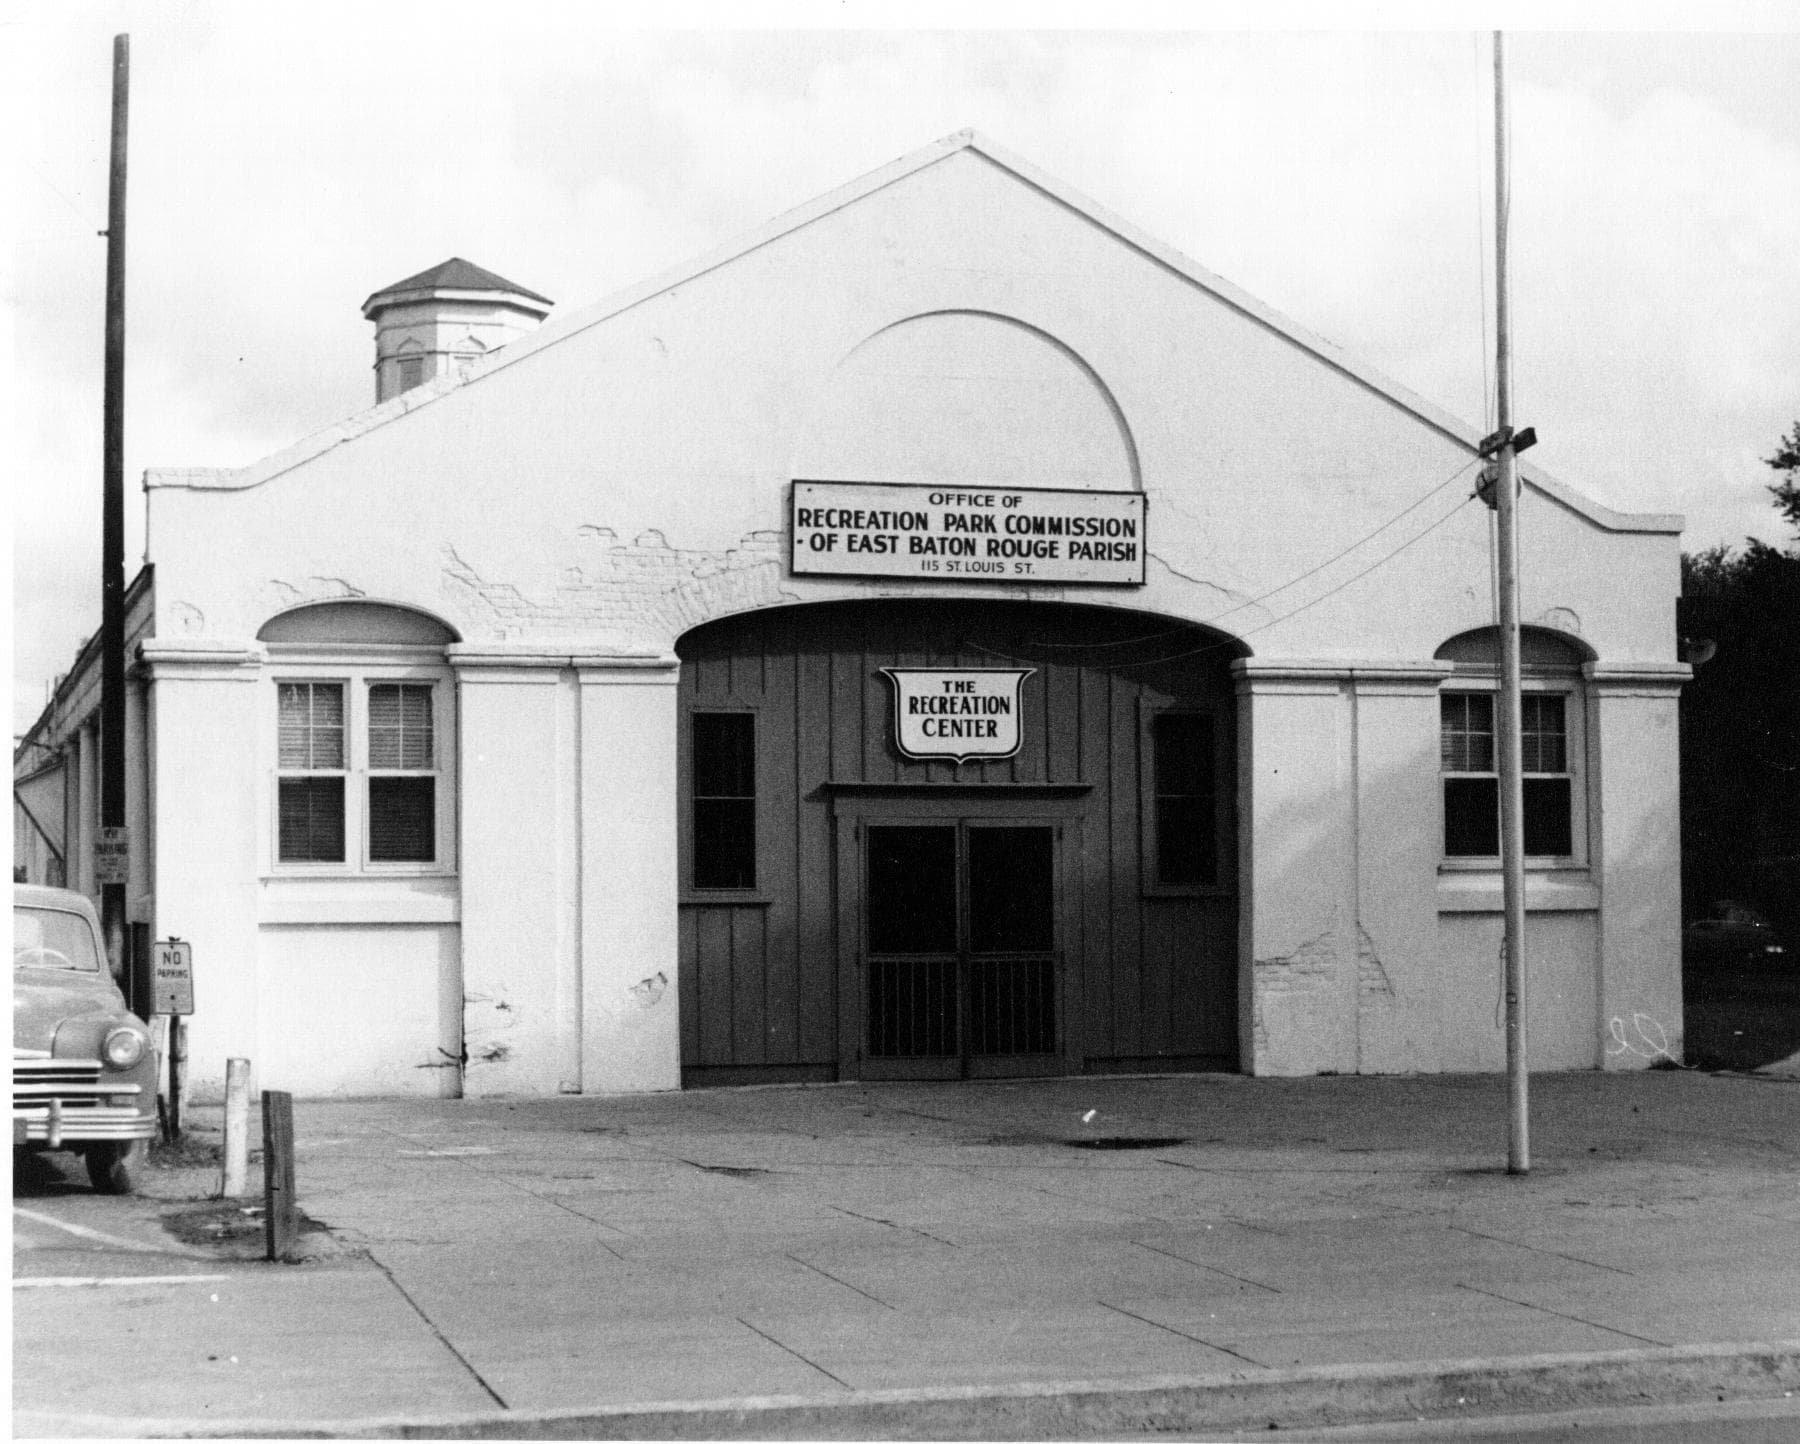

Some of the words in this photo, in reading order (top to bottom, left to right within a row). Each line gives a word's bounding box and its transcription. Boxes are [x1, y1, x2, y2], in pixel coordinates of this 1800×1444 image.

[928, 492, 995, 508] OFFICE
[1001, 495, 1023, 509] OF
[797, 507, 929, 532] RECREATION
[943, 513, 997, 534] PARK
[1004, 514, 1136, 538] COMMISSION
[809, 532, 839, 553] OF
[847, 533, 899, 555] EAST
[909, 535, 977, 557] BATON
[986, 538, 1060, 559] ROUGE
[1068, 540, 1137, 562] PARISH
[921, 559, 940, 572] 115
[965, 560, 1005, 574] LOUIS
[1014, 562, 1036, 574] ST.
[941, 680, 977, 694] THE
[908, 695, 1011, 715] RECREATION
[921, 717, 999, 738] CENTER
[162, 951, 181, 965] NO
[157, 968, 188, 979] PARKING
